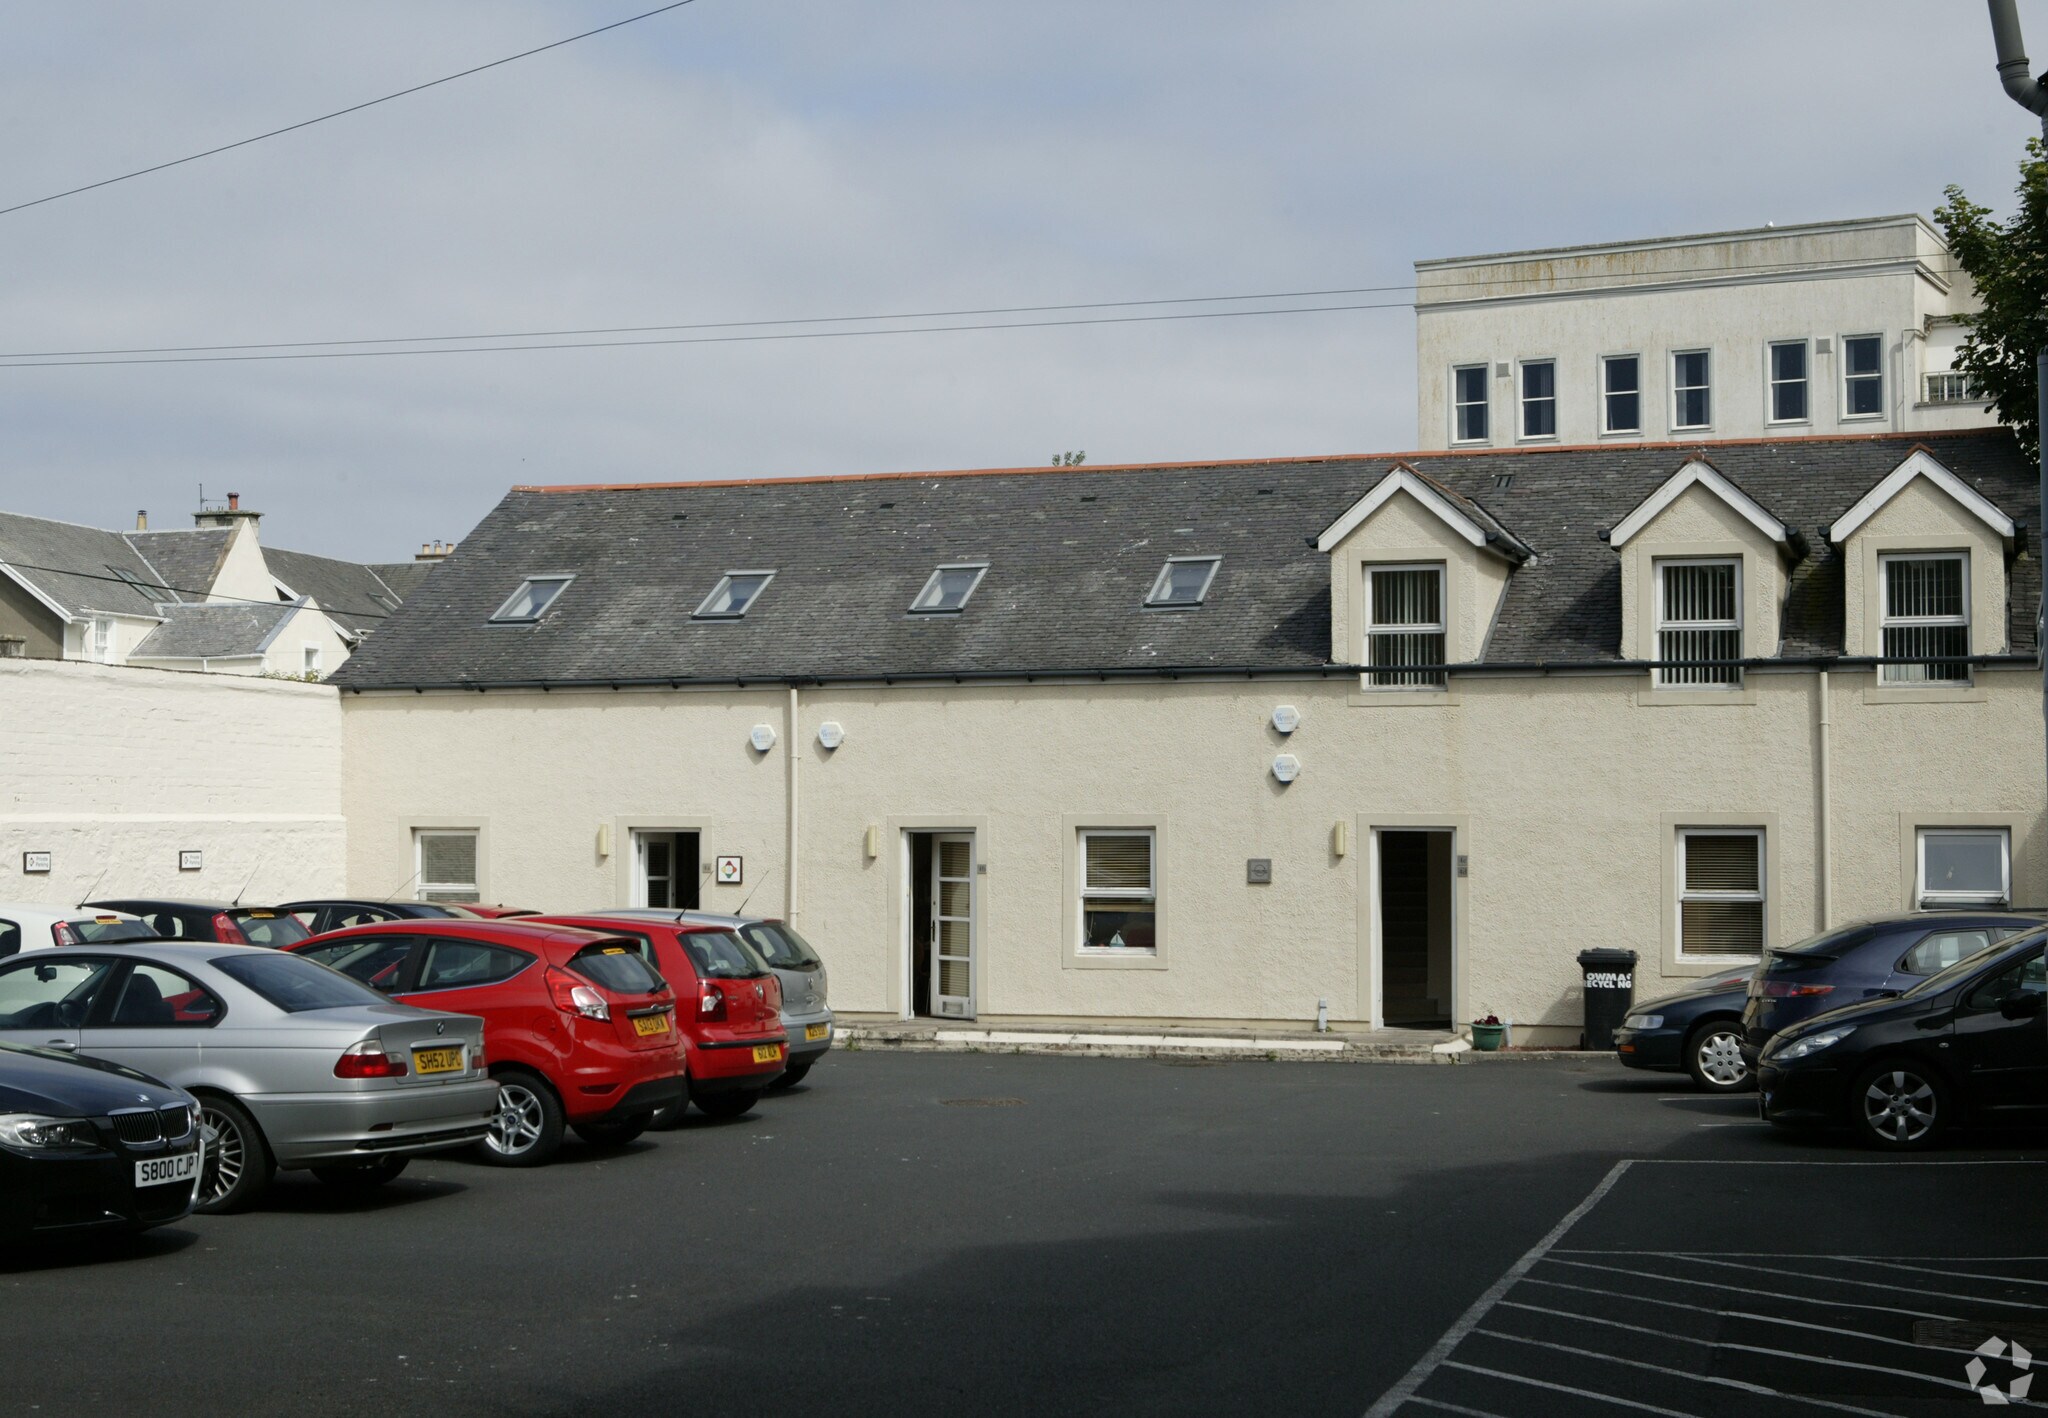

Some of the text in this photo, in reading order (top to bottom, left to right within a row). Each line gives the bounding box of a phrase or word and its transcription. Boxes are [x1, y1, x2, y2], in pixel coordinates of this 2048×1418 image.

[419, 1052, 445, 1070] SH52
[141, 1155, 194, 1182] S800 CJP
